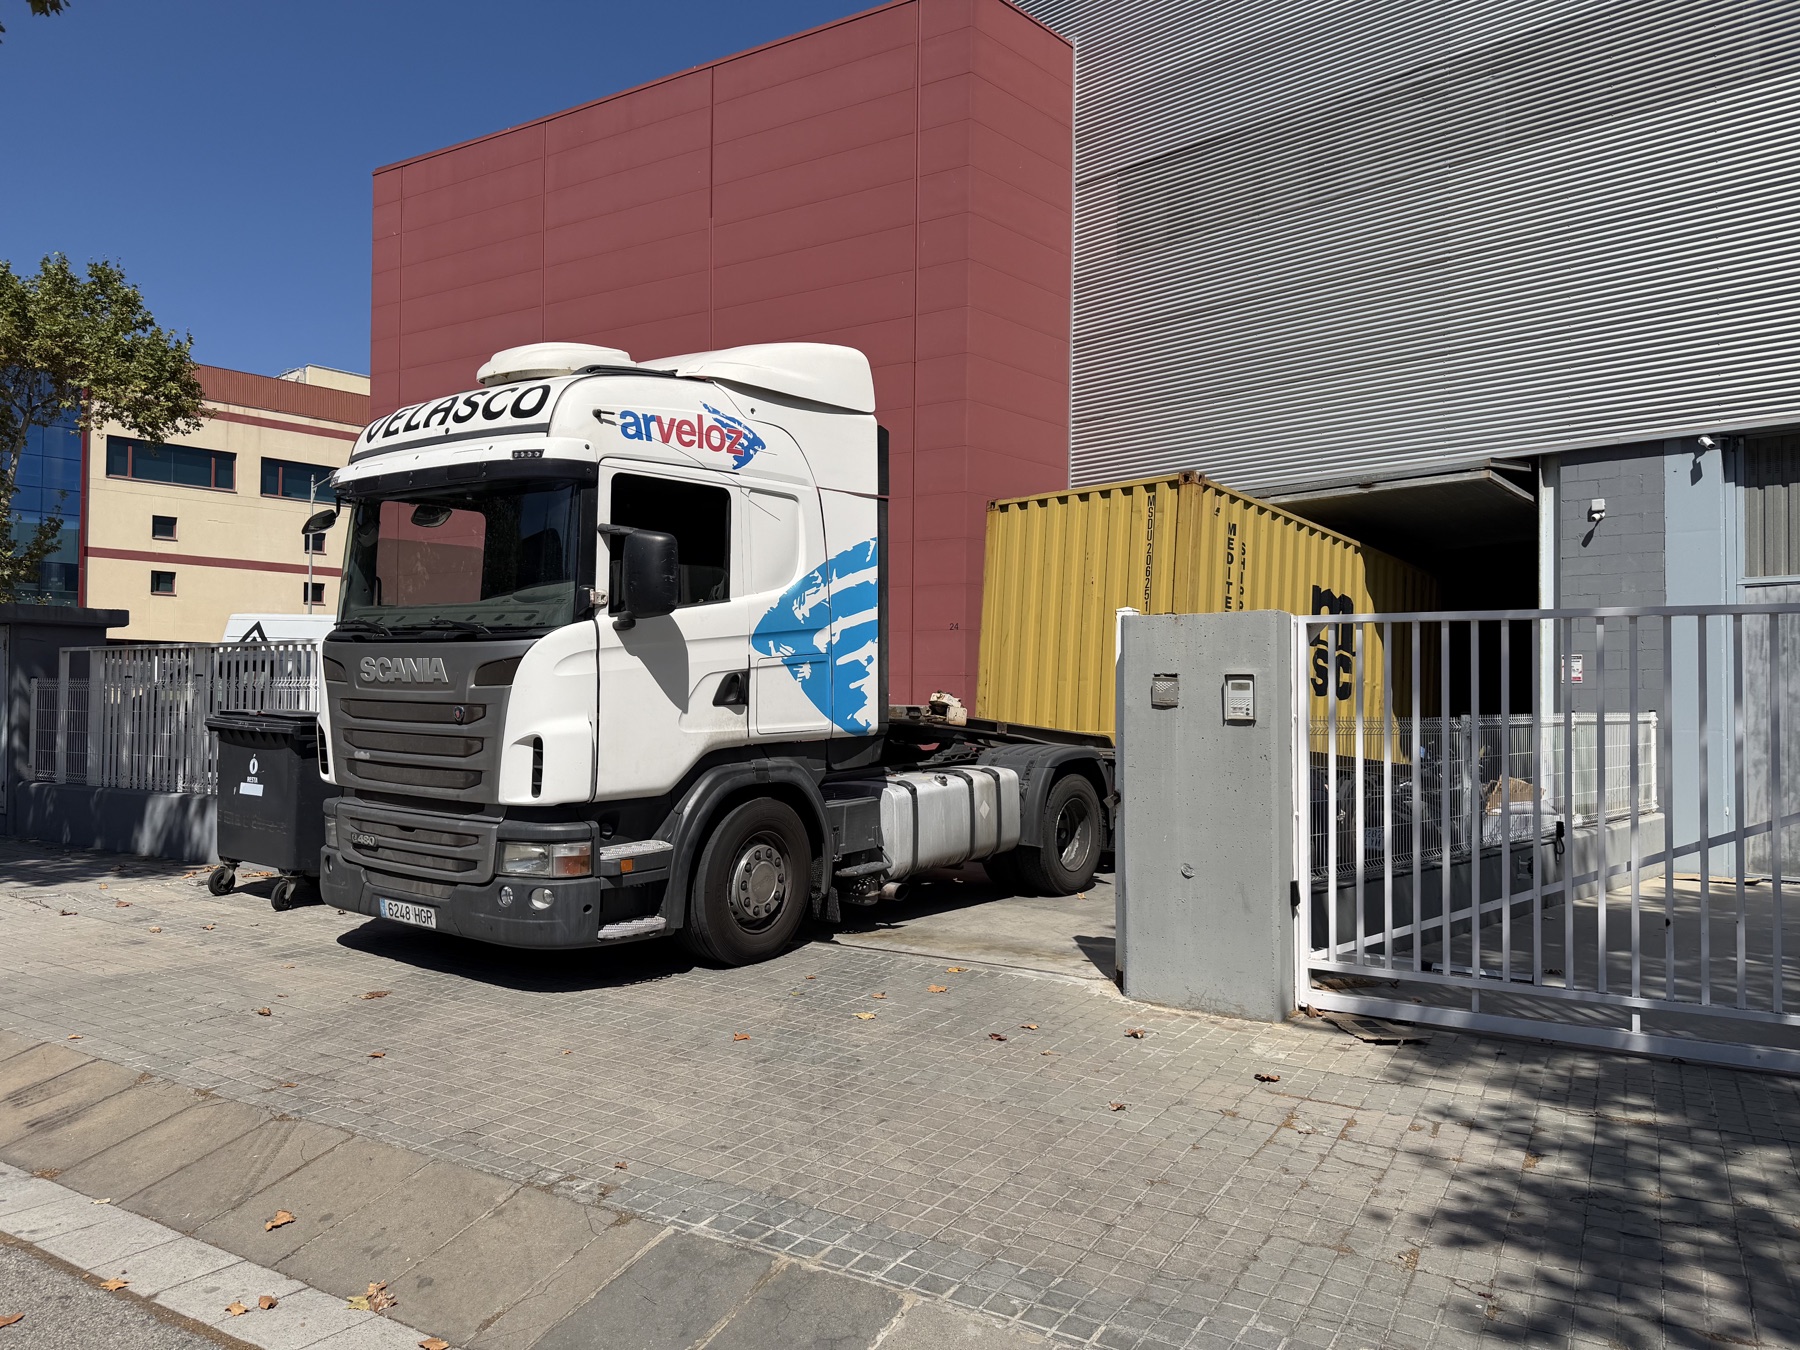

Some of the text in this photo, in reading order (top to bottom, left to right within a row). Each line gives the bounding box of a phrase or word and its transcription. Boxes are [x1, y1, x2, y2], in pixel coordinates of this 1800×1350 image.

[367, 385, 551, 443] VELASCO
[619, 410, 744, 456] arveloz
[1224, 522, 1237, 612] MEDITE
[949, 622, 959, 631] 24
[360, 656, 449, 683] SCANIA
[388, 902, 433, 926] 6248 HGR
